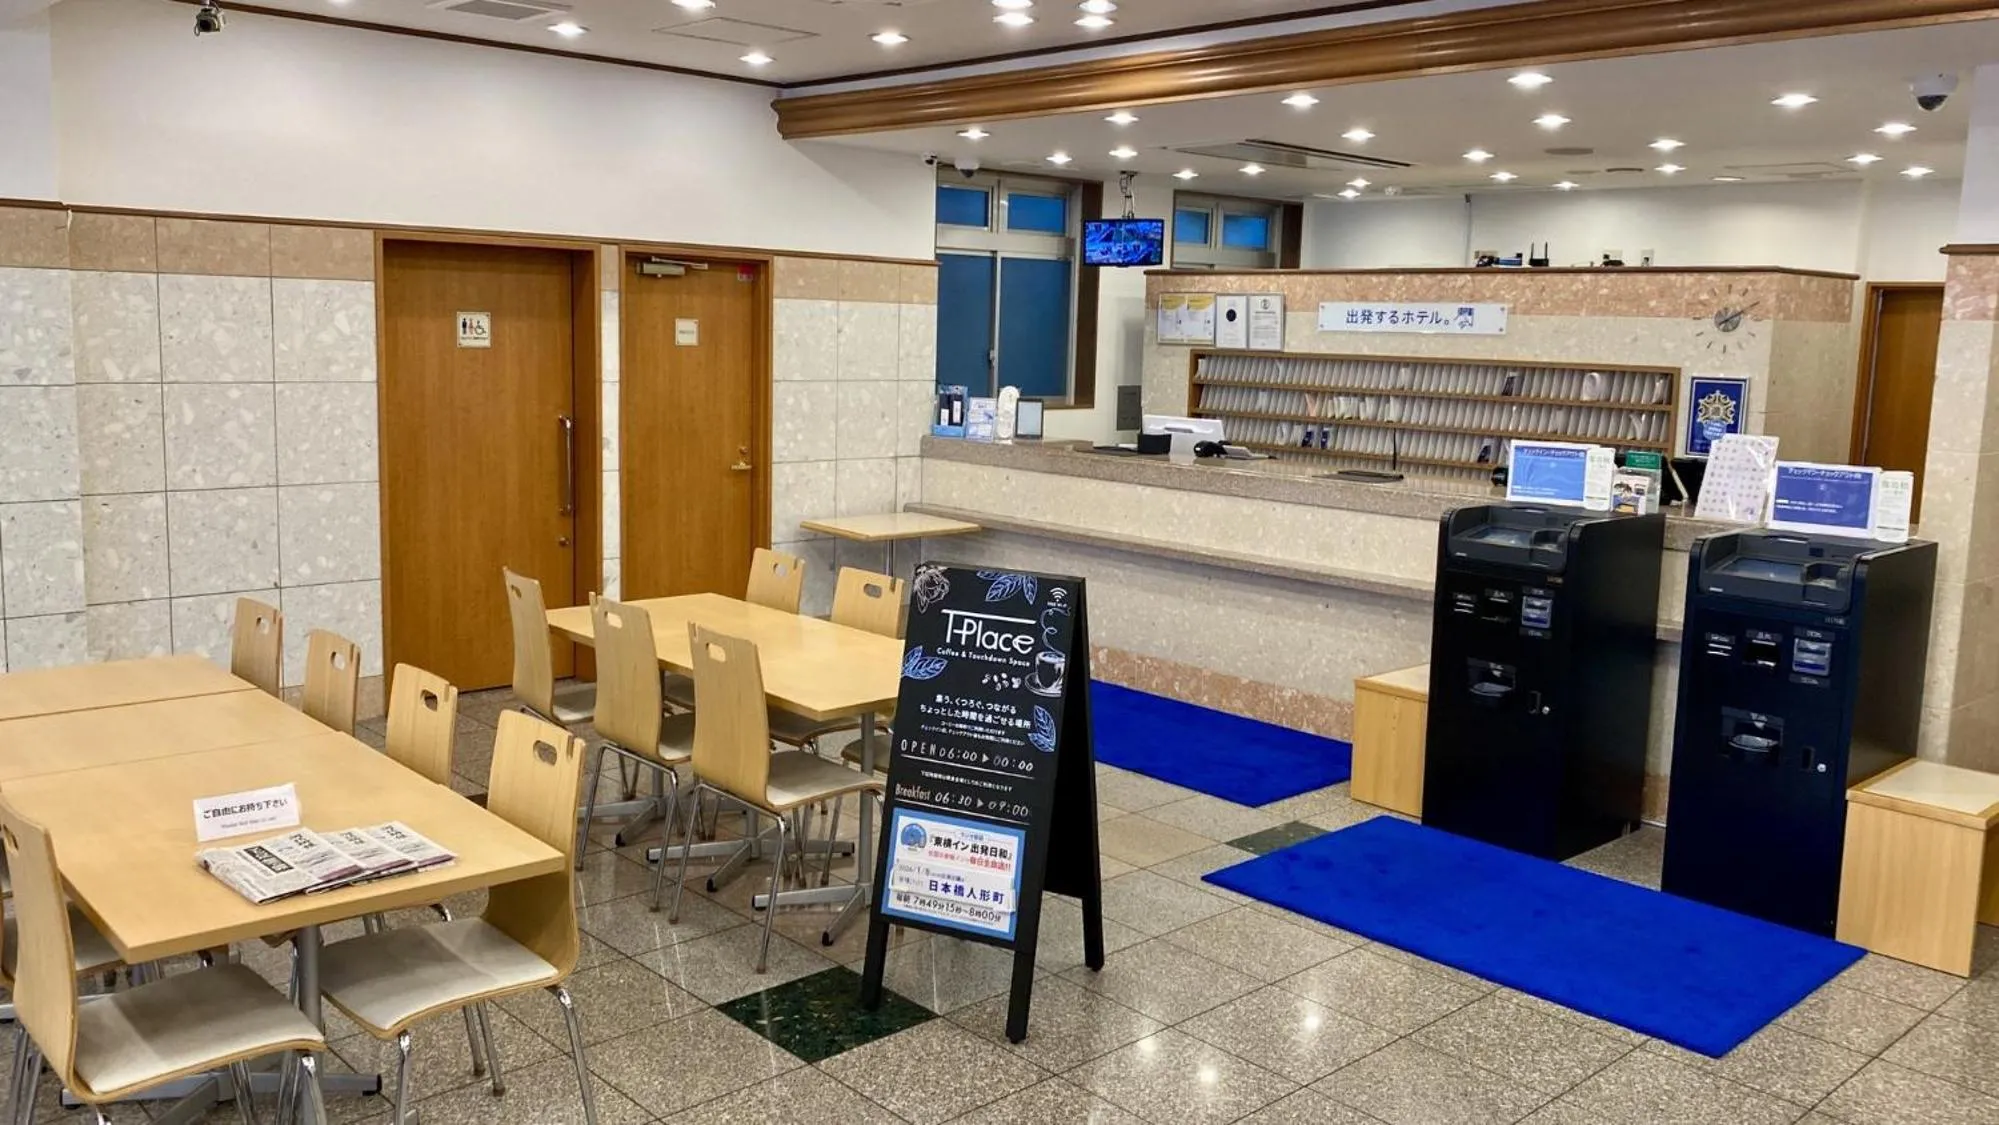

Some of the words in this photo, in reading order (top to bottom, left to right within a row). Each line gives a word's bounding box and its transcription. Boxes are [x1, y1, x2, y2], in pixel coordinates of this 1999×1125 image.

[1345, 309, 1450, 326] 出発するホテル。
[941, 609, 1036, 654] T-Place
[936, 647, 960, 657] Coffee
[961, 650, 967, 658] &
[968, 651, 1007, 664] Touchdown
[1008, 657, 1031, 667] Space
[900, 739, 936, 756] OPEN
[939, 747, 978, 762] 06:00
[993, 756, 1034, 772] 00:00
[203, 798, 288, 819] ご自由にお持ち下さい
[895, 783, 931, 801] Breakfast
[935, 791, 972, 807] 06:30
[988, 800, 1029, 817] 09:00
[928, 879, 1005, 905] 日本橋人形町
